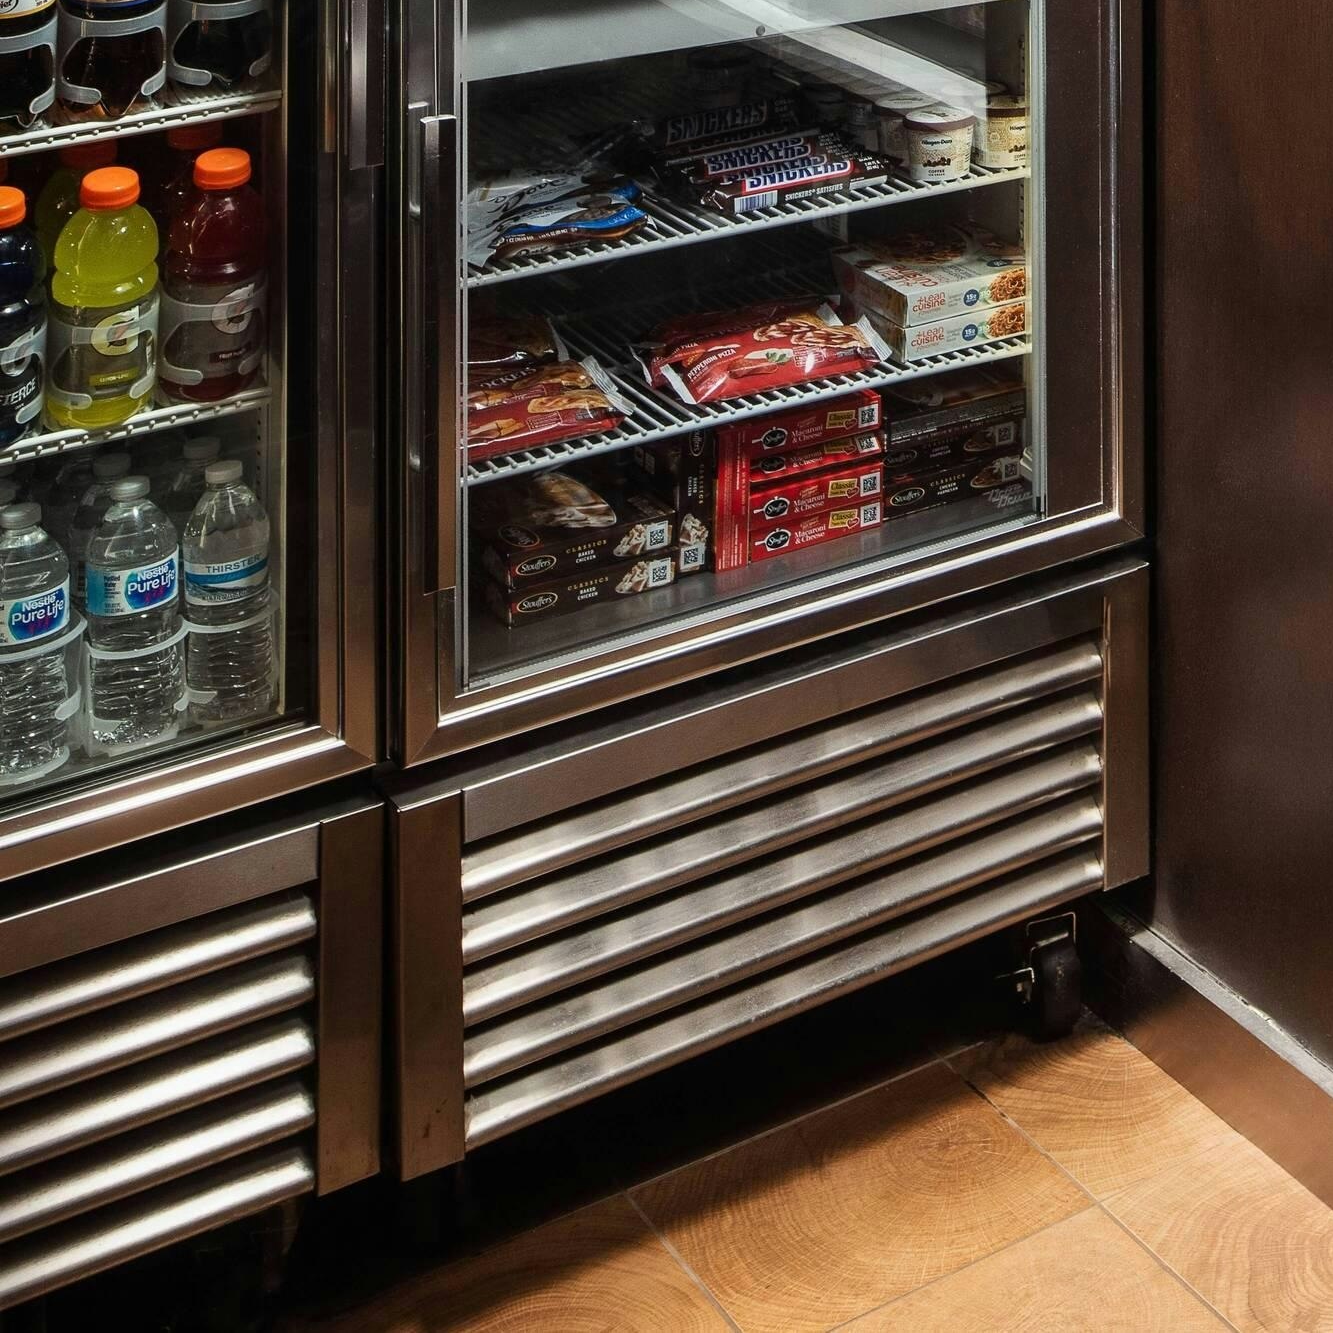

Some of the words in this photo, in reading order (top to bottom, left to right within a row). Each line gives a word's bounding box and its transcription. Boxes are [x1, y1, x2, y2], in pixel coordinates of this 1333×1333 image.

[816, 183, 844, 196] SATISFIES
[912, 297, 946, 313] cuisine
[911, 333, 945, 348] cuisine
[687, 353, 718, 380] PEPPERONI
[717, 348, 737, 361] PIZZA
[792, 424, 824, 437] Macaroni
[797, 431, 823, 443] Cheese
[831, 480, 855, 490] Classic
[793, 493, 825, 507] Macaroni
[800, 500, 825, 512] Cheese
[831, 511, 856, 521] Classic
[794, 524, 826, 539] Macaroni
[801, 530, 826, 543] Cheese
[575, 554, 597, 564] CHICKEN
[578, 549, 595, 558] BAKED
[127, 575, 160, 596] Pure
[161, 568, 176, 588] Life
[577, 591, 599, 601] CHICKEN
[580, 586, 597, 595] BAKED
[12, 609, 46, 626] Pure
[47, 600, 64, 619] Life
